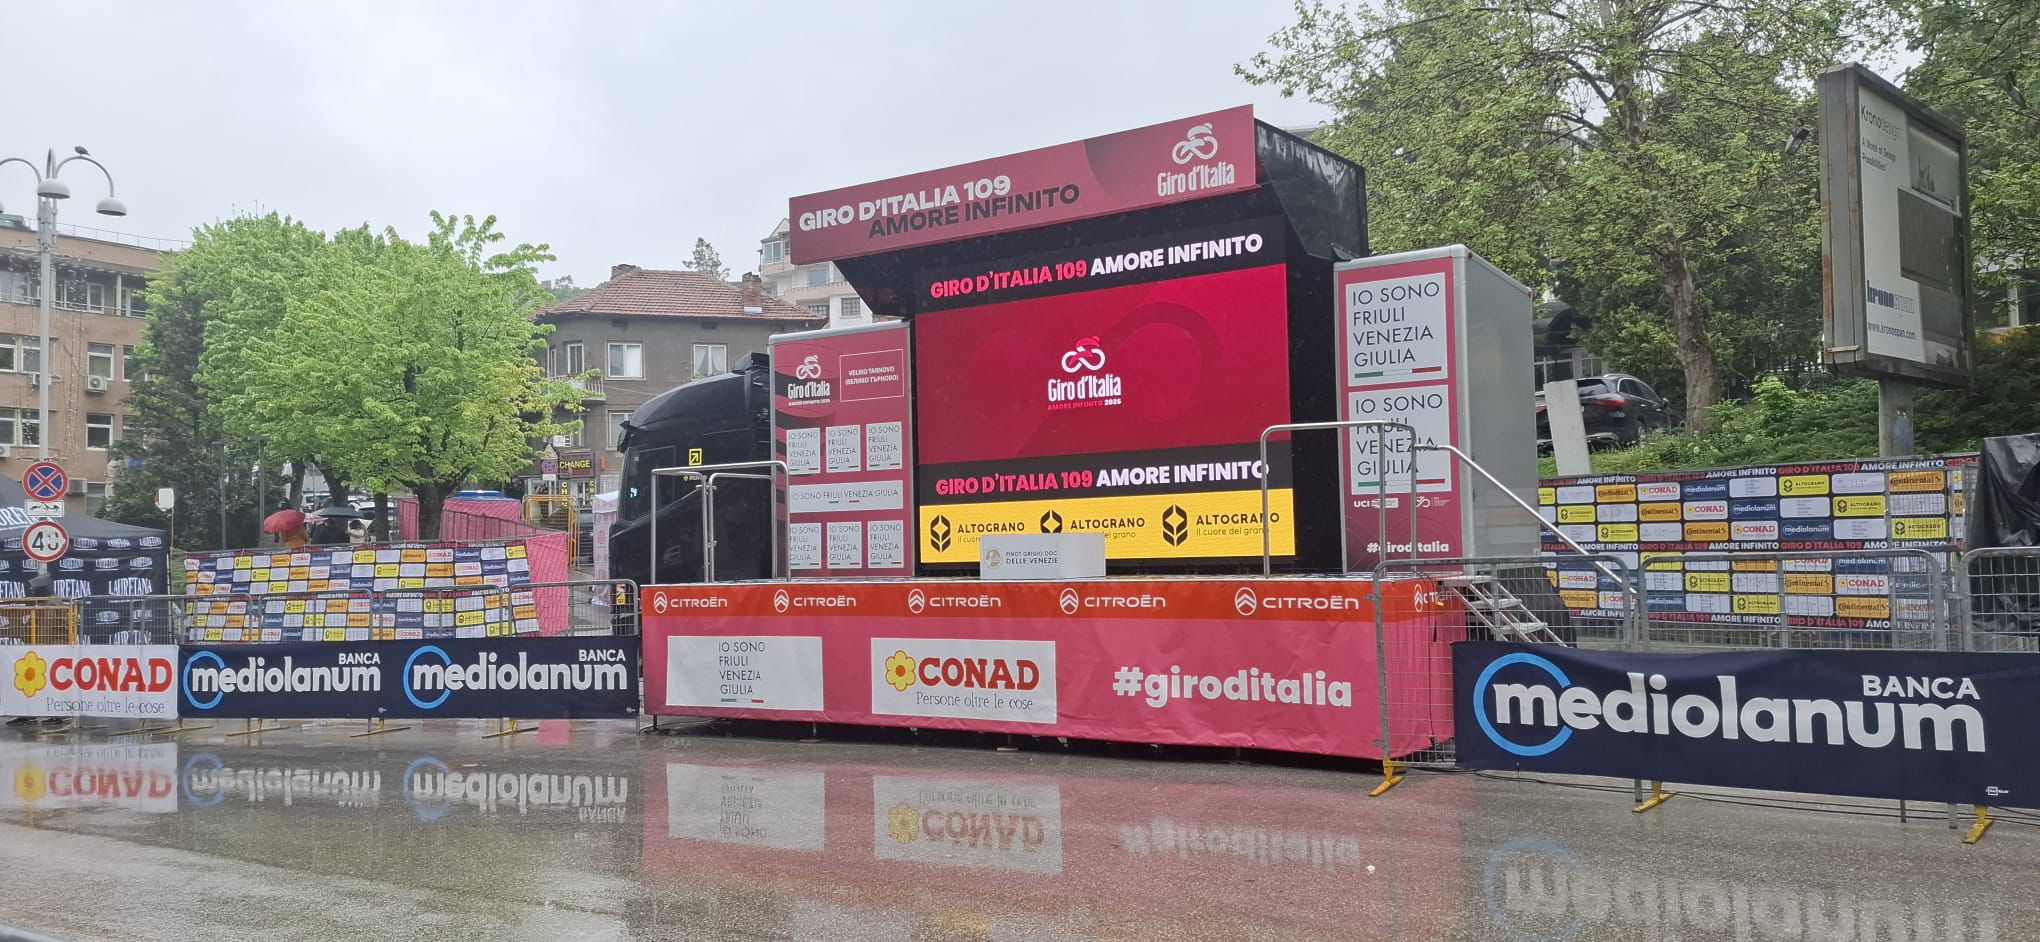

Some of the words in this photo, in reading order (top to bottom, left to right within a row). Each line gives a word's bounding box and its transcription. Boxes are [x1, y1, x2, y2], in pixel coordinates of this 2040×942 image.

[1157, 172, 1186, 197] Giro
[1188, 161, 1235, 191] d'Italia
[800, 205, 854, 232] GIRO
[859, 185, 960, 221] D'ITALIA
[964, 175, 1011, 200] 109
[868, 205, 959, 239] AMORE
[965, 183, 1080, 222] INFINITO
[930, 278, 973, 298] GIRO
[976, 266, 1052, 293] D'ITALIA
[1055, 260, 1087, 281] 109
[1091, 248, 1164, 276] AMORE
[1168, 233, 1263, 265] INFINITO
[1353, 290, 1373, 306] IO
[1380, 281, 1439, 303] SONO
[1353, 306, 1404, 327] FRIULI
[1353, 324, 1434, 347] VENEZIA
[1354, 348, 1416, 367] GIULIA
[788, 383, 804, 399] Giro
[805, 381, 831, 397] d'Italia
[1048, 379, 1075, 402] Giro
[1077, 373, 1121, 400] d'Italia
[1073, 400, 1103, 409] INFINITO
[1104, 398, 1122, 406] 2026
[1356, 398, 1376, 414] IO
[1383, 393, 1443, 412] SONO
[837, 429, 858, 437] SONO
[878, 425, 900, 433] SONO
[828, 448, 857, 456] VENEZIA
[869, 444, 898, 453] VENEZIA
[828, 457, 850, 465] GIULIA
[869, 454, 891, 462] GIULIA
[560, 460, 591, 469] CHANGE
[1706, 470, 1737, 478] AMORE
[1738, 467, 1777, 476] INFINITO
[1861, 462, 1898, 471] AMORE
[1899, 459, 1945, 469] INFINITO
[936, 477, 979, 495] GIRO
[982, 473, 1058, 494] D'ITALIA
[1061, 470, 1093, 489] 109
[1096, 466, 1170, 487] AMORE
[1174, 461, 1269, 483] INFINITO
[1577, 476, 1602, 485] AMORE
[1602, 476, 1636, 484] INFINITO
[800, 492, 821, 500] SONO
[823, 491, 843, 499] FRIULI
[844, 490, 874, 498] VENEZIA
[875, 489, 898, 497] GIULIA
[1685, 484, 1726, 493] mediolanum
[1354, 500, 1370, 508] UCI
[1695, 505, 1725, 513] CONAD
[1734, 504, 1776, 512] mediolanum
[839, 525, 860, 533] SONO
[958, 522, 1025, 533] ALTOGRANO
[1070, 518, 1145, 530] ALTOGRANO
[1784, 524, 1830, 533] mediolanum
[1113, 531, 1136, 539] grano
[1229, 526, 1242, 535] del
[1367, 541, 1449, 553] #irodtalia
[1709, 542, 1740, 550] AMORE
[1741, 542, 1779, 550] INFINITO
[829, 553, 851, 561] GIULIA
[870, 552, 893, 560] GIULIA
[54, 579, 91, 599] URETANA
[109, 577, 152, 596] LAURETANA
[1848, 580, 1885, 588] CONAD
[671, 596, 728, 608] CITROËN
[793, 595, 856, 607] CITROËN
[930, 595, 1002, 608] CITROËN
[1084, 595, 1166, 609] CITROËN
[1262, 595, 1359, 610] CITROËN
[1743, 616, 1781, 624] INFINITO
[718, 642, 730, 653] IO
[733, 641, 766, 653] SONO
[338, 653, 381, 665] BANCA
[578, 649, 626, 662] BANCA
[719, 656, 749, 667] FRIULI
[49, 657, 173, 693] CONAD
[191, 656, 381, 693] mediolanum
[413, 651, 628, 691] mediolanum
[719, 670, 761, 681] VENEZIA
[918, 657, 1040, 691] CONAD
[720, 684, 753, 695] GIULIA
[1112, 665, 1352, 708] #giroditalia
[1861, 675, 1981, 700] BANCA
[46, 697, 93, 712] Persone
[97, 698, 121, 713] oltre
[125, 700, 136, 714] le
[139, 702, 165, 714] cose
[916, 691, 960, 707] Persone
[964, 693, 990, 709] oltre
[995, 694, 1004, 709] le
[1009, 699, 1033, 711] cose
[1494, 672, 1987, 753] mediolanum
